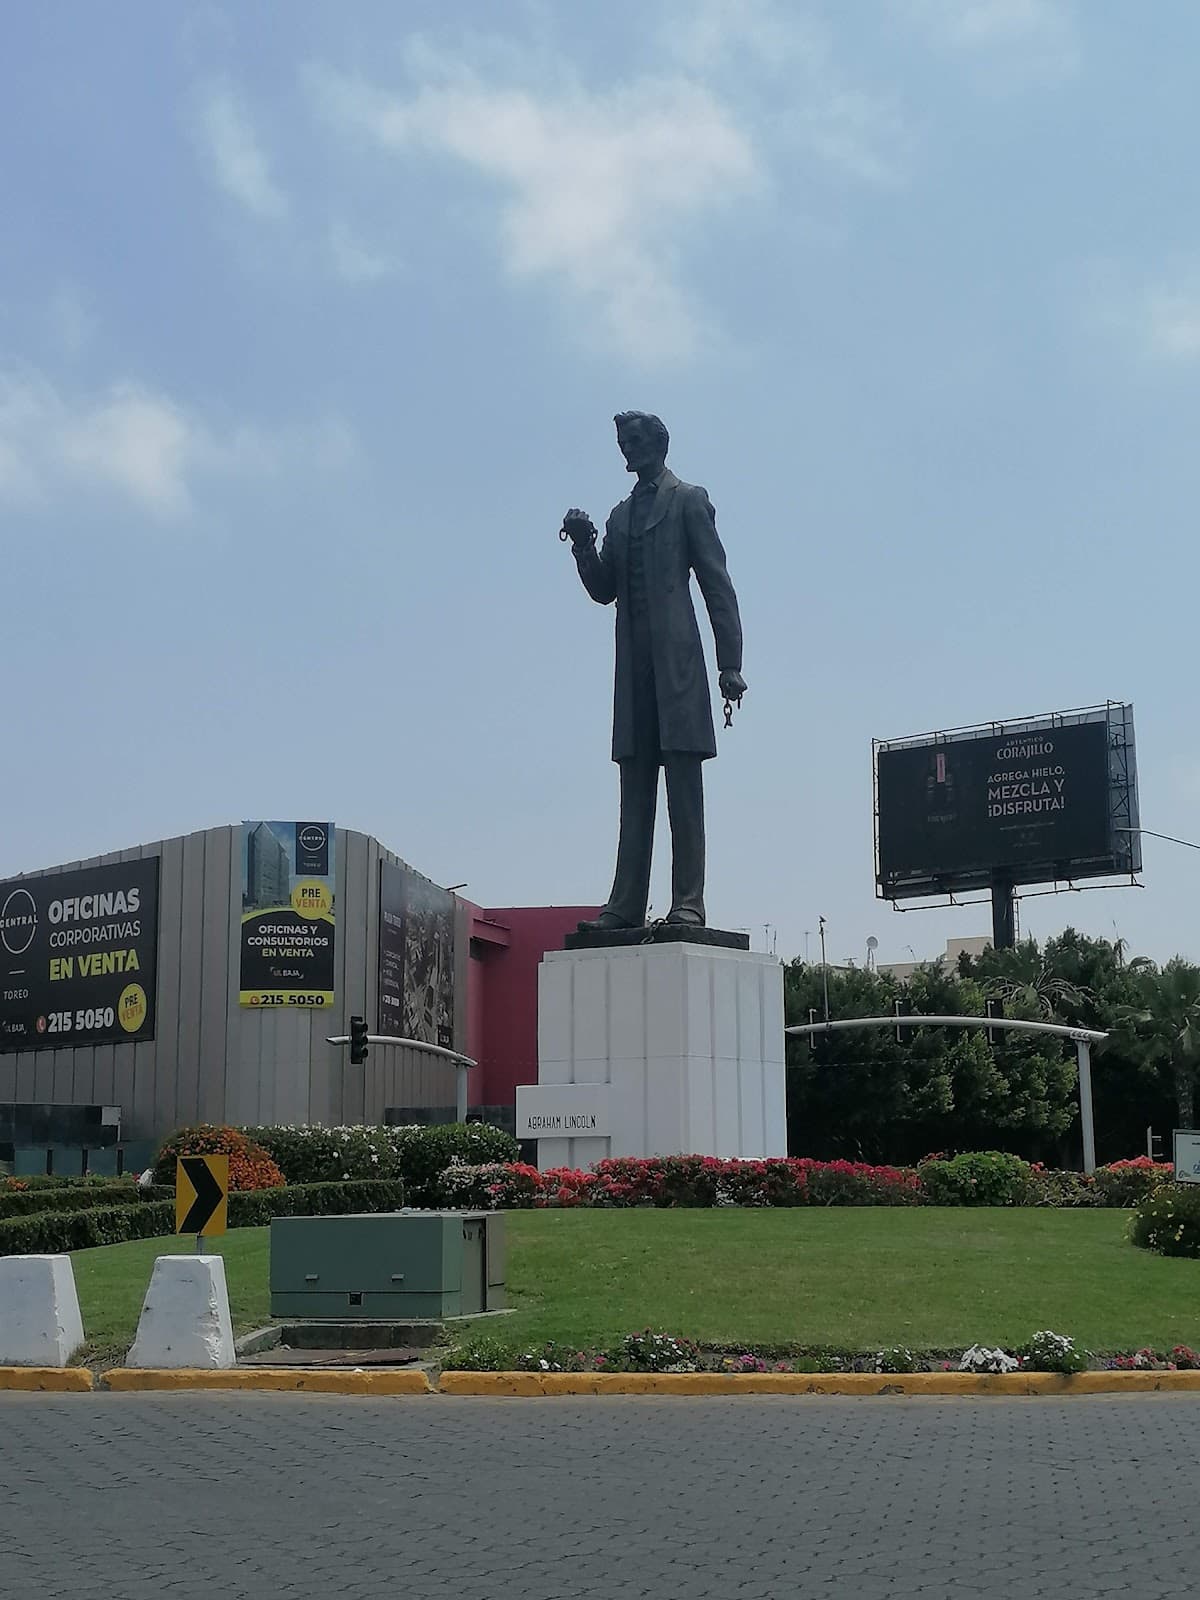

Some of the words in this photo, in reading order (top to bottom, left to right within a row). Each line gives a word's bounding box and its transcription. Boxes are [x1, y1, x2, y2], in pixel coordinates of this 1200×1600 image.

[997, 742, 1054, 760] CORAJILLO
[988, 771, 1029, 783] AGREGA
[988, 782, 1050, 801] MEZCLA
[1053, 779, 1065, 793] Y
[988, 797, 1065, 817] ¡DISFRUTA!
[302, 888, 321, 898] PRE
[48, 888, 140, 924] OFICINAS
[296, 898, 327, 909] VENTA
[0, 914, 39, 928] CENTRAL
[49, 920, 141, 947] CORPORATIVAS
[258, 925, 308, 935] OFICINAS
[310, 925, 318, 935] Y
[247, 936, 329, 946] CONSULTORIOS
[262, 948, 277, 957] EN
[279, 948, 315, 957] VENTA
[49, 957, 73, 981] EN
[77, 949, 140, 977] VENTA
[3, 988, 29, 1000] TOREO
[124, 993, 138, 1008] PRE
[260, 995, 284, 1004] 215
[288, 995, 325, 1004] 5050
[48, 1011, 73, 1033] 215
[75, 1006, 114, 1030] 5050
[528, 1116, 561, 1129] ABRAHAM
[564, 1115, 596, 1129] LINCOLN
